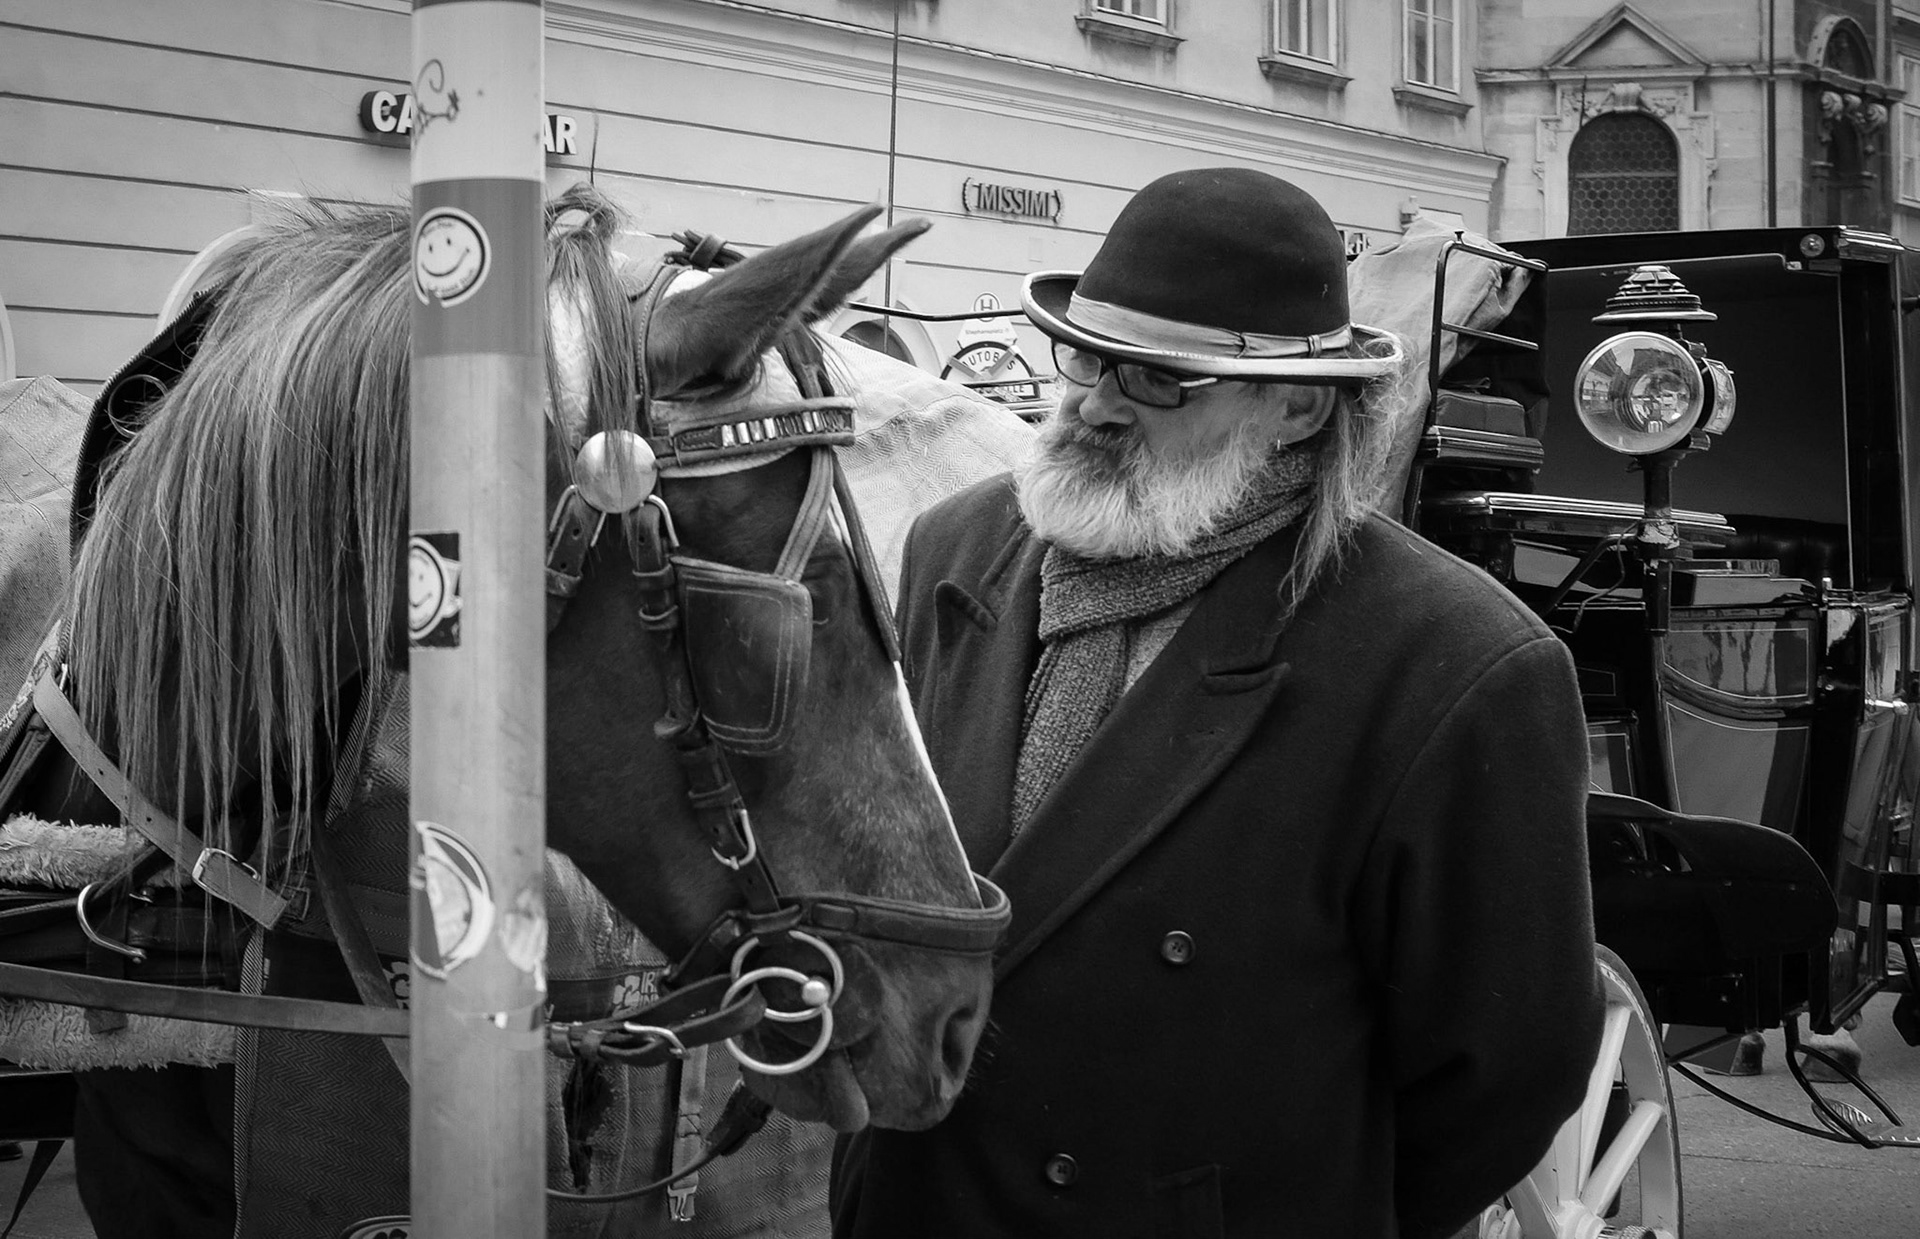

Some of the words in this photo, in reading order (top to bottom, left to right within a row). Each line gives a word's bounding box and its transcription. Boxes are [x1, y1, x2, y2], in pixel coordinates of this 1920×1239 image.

[362, 91, 413, 134] CA
[543, 114, 578, 155] AR
[962, 350, 1016, 371] UTOBS
